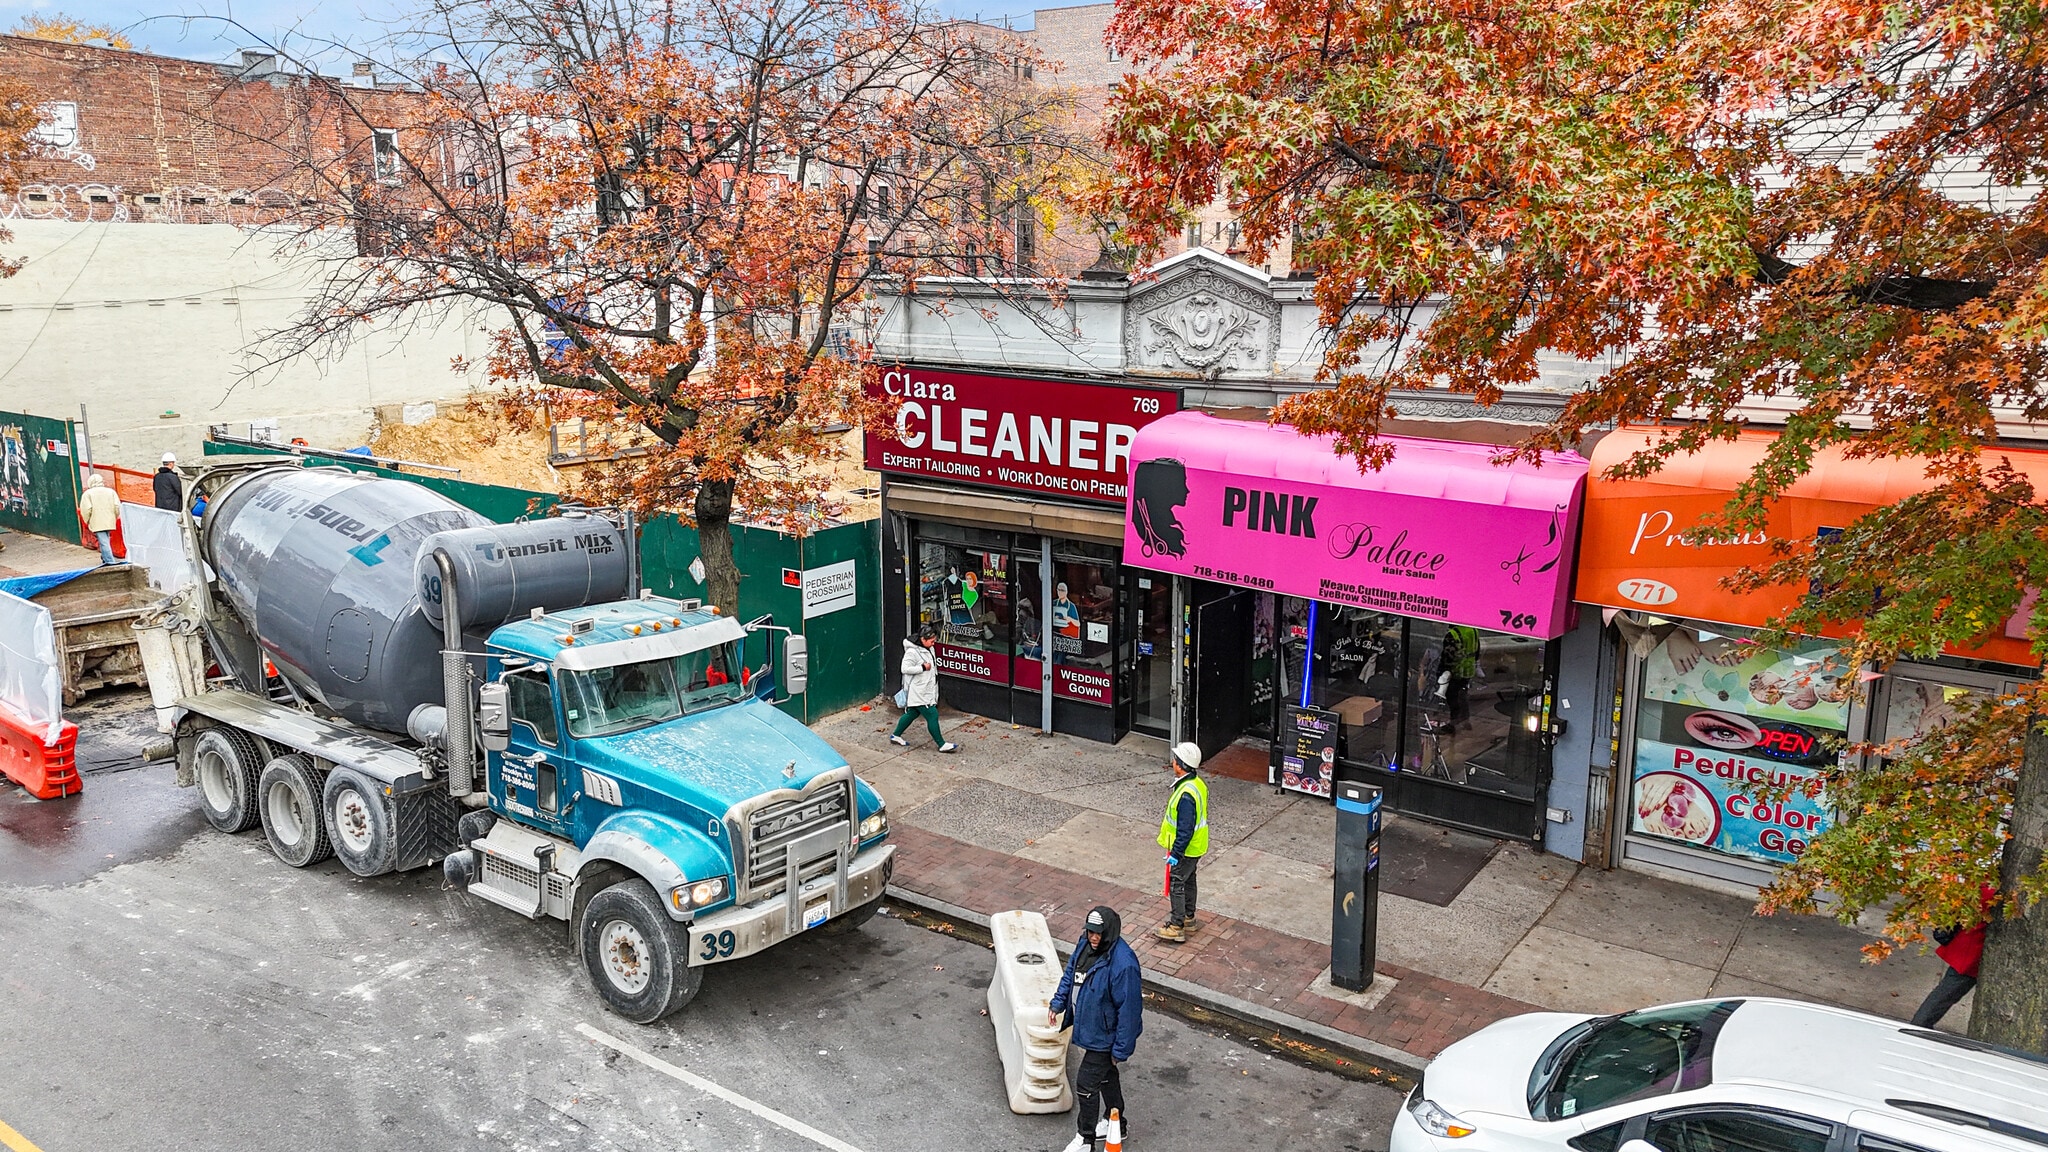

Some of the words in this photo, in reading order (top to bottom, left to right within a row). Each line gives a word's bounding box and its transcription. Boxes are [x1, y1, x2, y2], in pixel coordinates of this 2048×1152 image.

[884, 371, 956, 401] Clara
[1132, 396, 1160, 414] 769
[896, 401, 1138, 475] CLEANER
[883, 452, 922, 470] EXPERT
[924, 457, 981, 477] TAILORING
[998, 467, 1033, 485] WORK
[1035, 472, 1068, 491] DONE
[1070, 479, 1088, 492] ON
[1090, 481, 1128, 498] PREMI
[1222, 486, 1319, 539] PINK
[1629, 510, 1769, 555] Preious
[475, 537, 568, 562] Transit
[574, 533, 613, 551] Mix
[588, 545, 615, 556] corp.
[1327, 522, 1449, 572] Palace
[805, 570, 854, 590] PEDESTRIAN
[1193, 565, 1275, 590] 718-618-0480
[1381, 566, 1405, 577] Hair
[1405, 569, 1436, 581] Salon
[420, 574, 442, 605] 39
[806, 581, 854, 600] CROSSWALK
[1318, 587, 1360, 603] EyeBrow
[1361, 593, 1402, 611] Shaping
[1403, 600, 1449, 618] Coloring
[1629, 581, 1667, 602] 771
[1500, 609, 1537, 631] 769
[936, 657, 968, 672] SUEDE
[969, 663, 991, 676] UGG
[942, 647, 984, 663] LEATHER
[1340, 653, 1364, 662] SALON
[1060, 669, 1111, 687] WEDDING
[1068, 683, 1102, 698] GOWN
[1756, 727, 1815, 754] OPEN
[760, 798, 841, 836] MACK
[1372, 811, 1378, 831] P
[1726, 794, 1821, 831] Color
[1759, 828, 1806, 856] Ge
[881, 856, 893, 888] 39
[700, 929, 736, 961] 39
